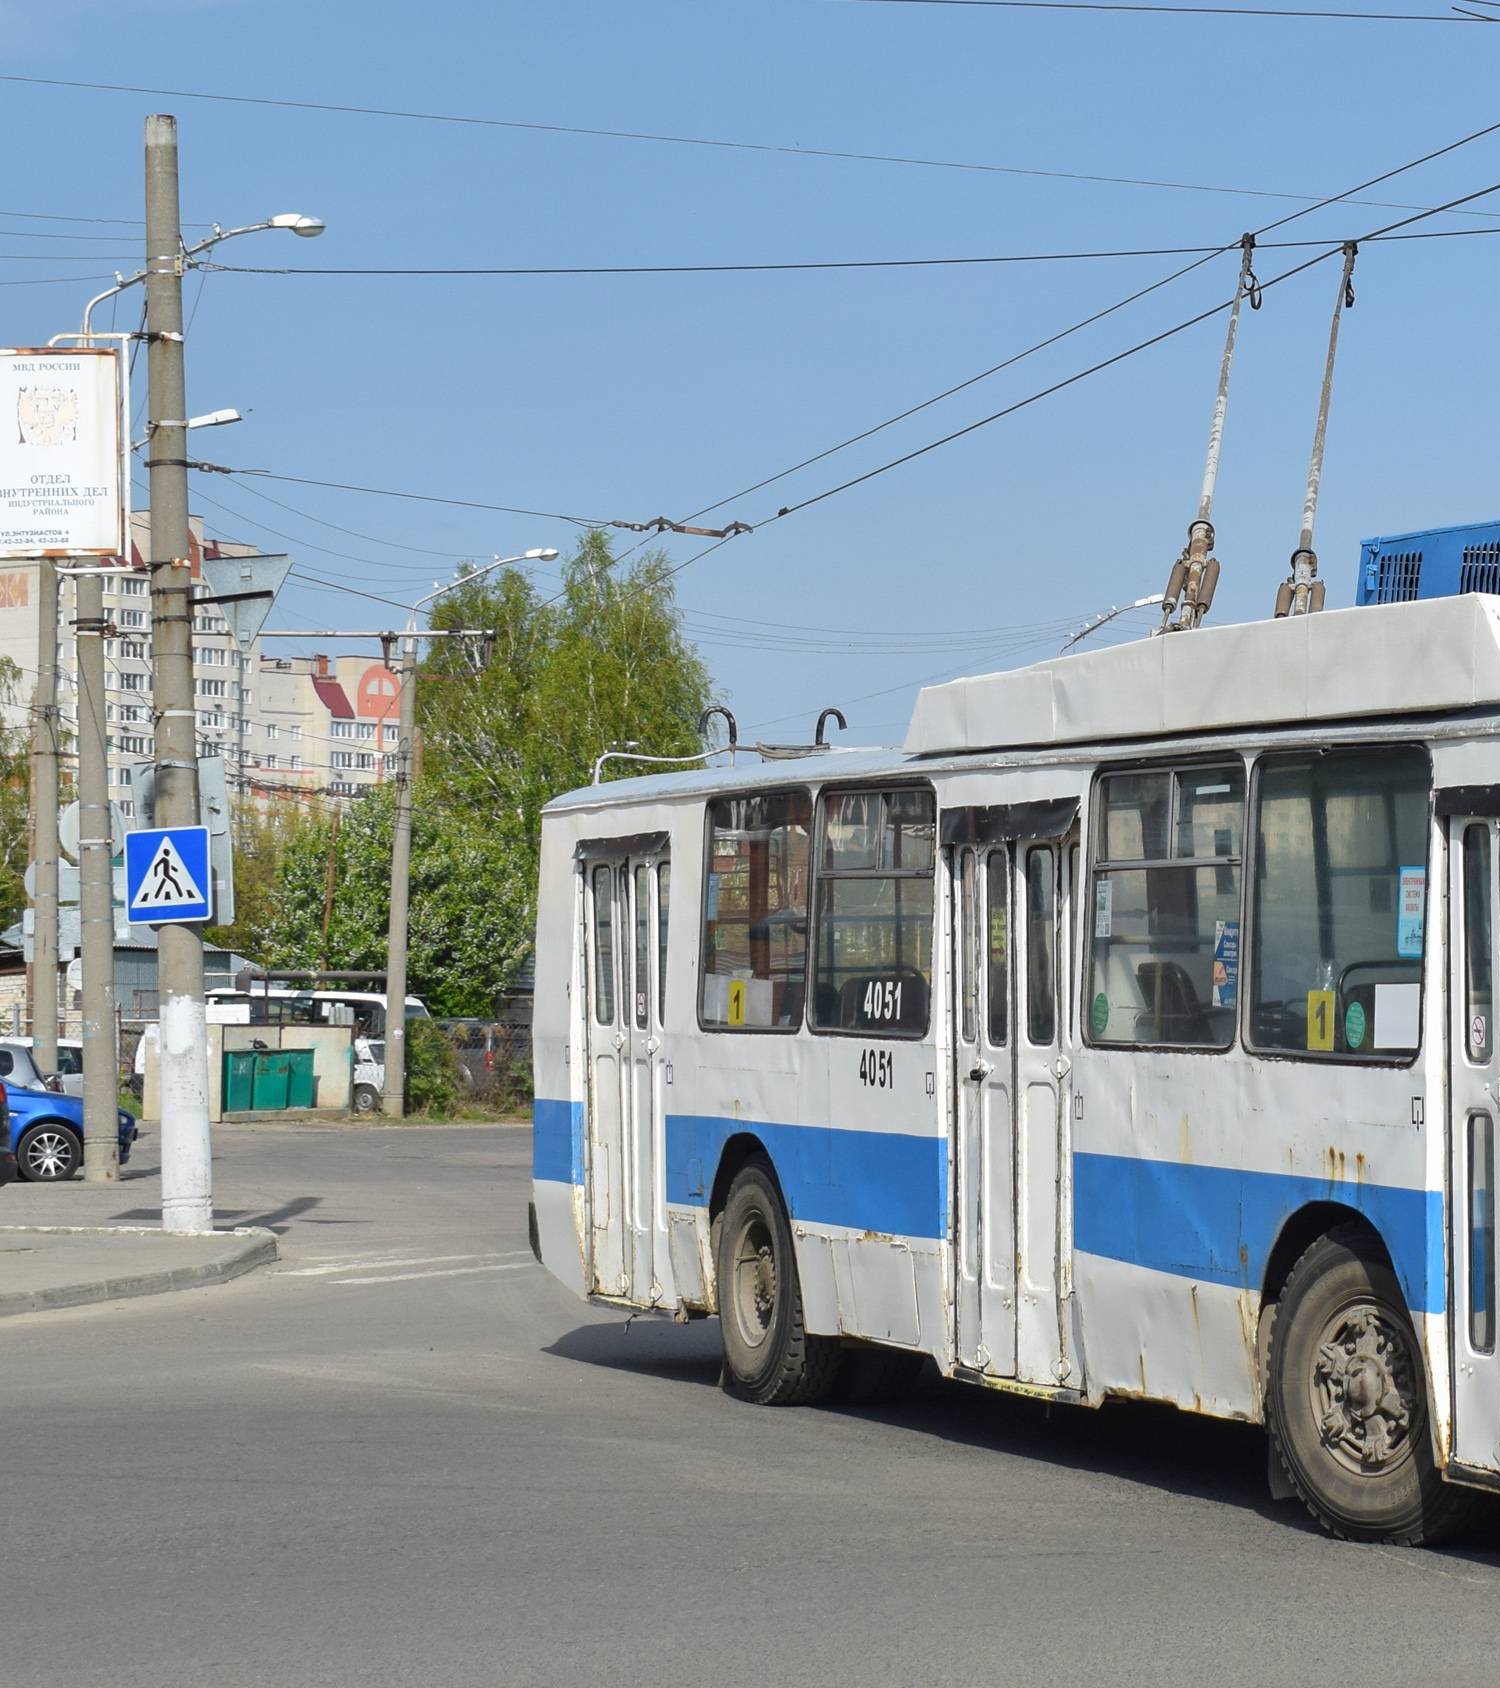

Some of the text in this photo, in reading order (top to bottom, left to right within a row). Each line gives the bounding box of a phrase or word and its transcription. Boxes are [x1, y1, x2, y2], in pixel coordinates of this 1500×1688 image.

[12, 362, 81, 372] МВД РОССИИ
[30, 474, 71, 485] ОТДЕЛ
[83, 486, 108, 498] ДЕЛ
[8, 499, 95, 508] ИНДУСТРИАЛЬНОГО
[33, 508, 69, 516] РАЙОНА
[733, 989, 741, 1020] 1
[863, 981, 903, 1021] 4051
[1315, 1000, 1326, 1040] 1
[859, 1049, 893, 1089] 4051
